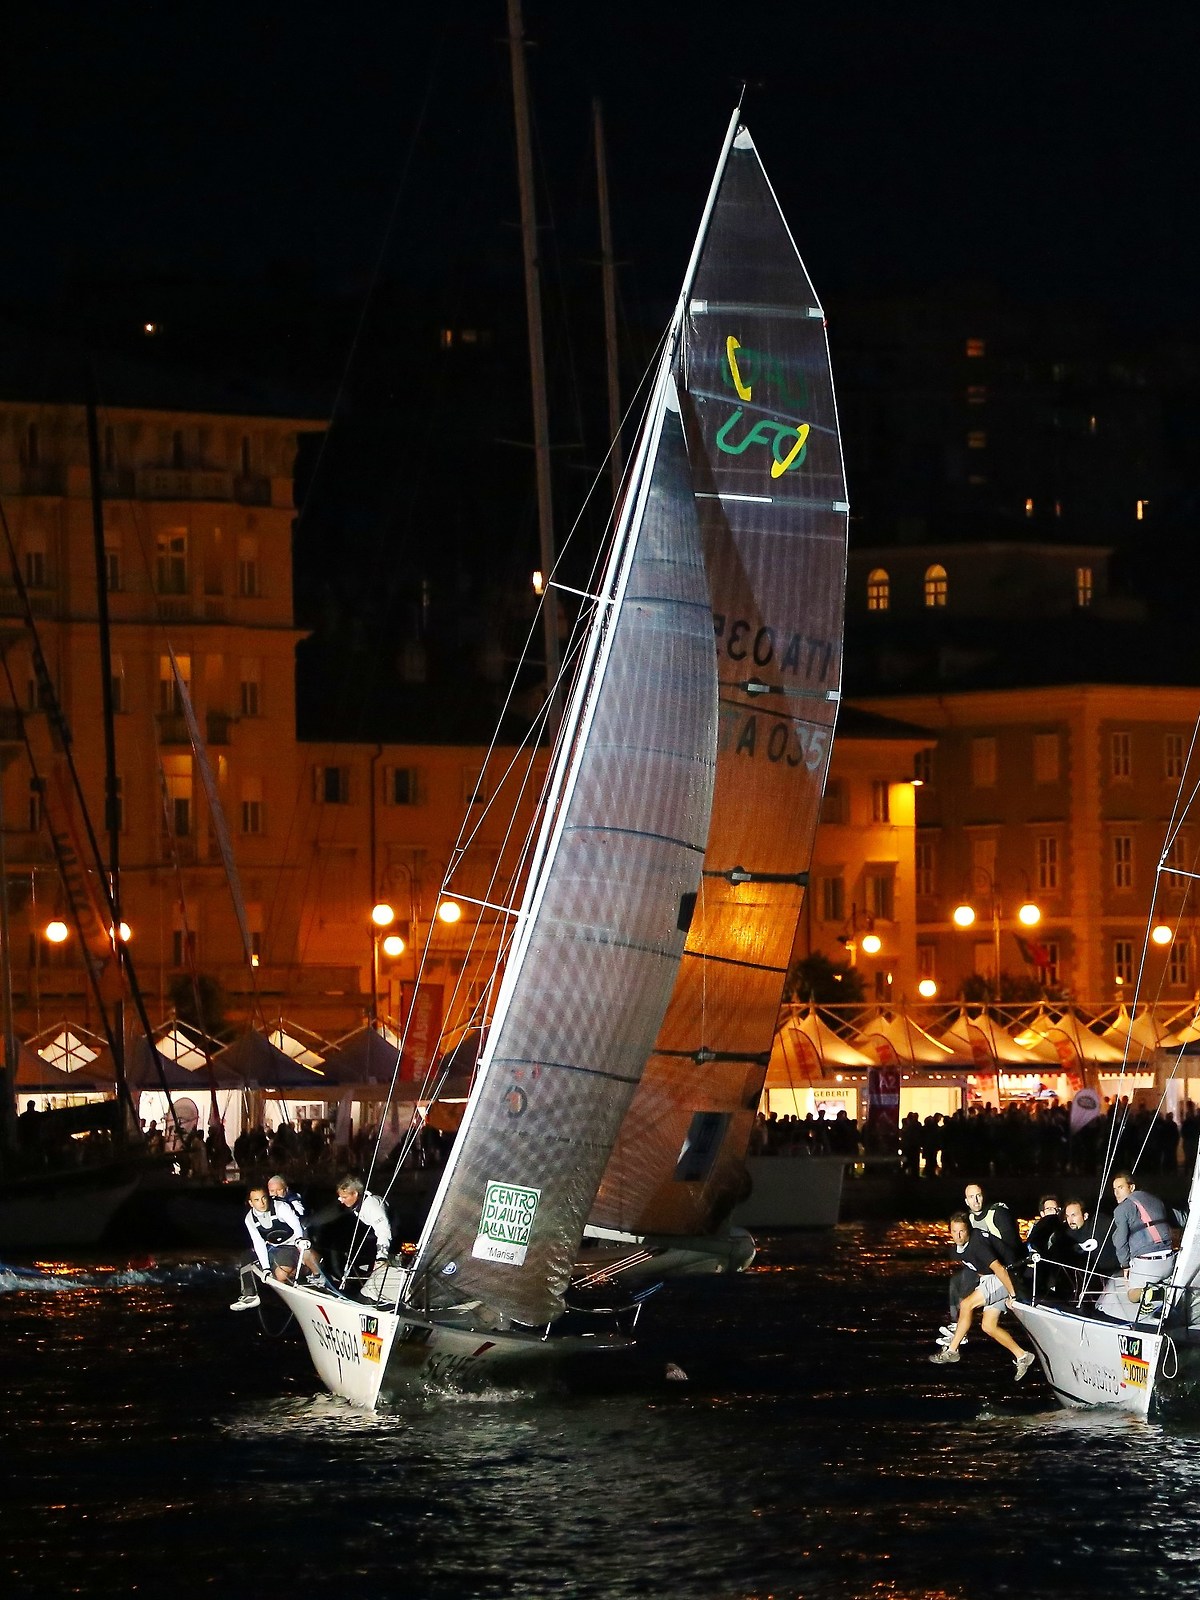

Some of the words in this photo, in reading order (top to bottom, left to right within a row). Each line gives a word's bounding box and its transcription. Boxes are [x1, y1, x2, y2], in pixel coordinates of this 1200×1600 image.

[716, 411, 809, 478] UFO
[814, 1090, 850, 1098] GEBERIT
[489, 1189, 536, 1210] CENTRO
[486, 1205, 499, 1219] DI
[498, 1207, 532, 1226] AIUTO
[483, 1221, 506, 1238] ALLA
[507, 1226, 529, 1242] VITA
